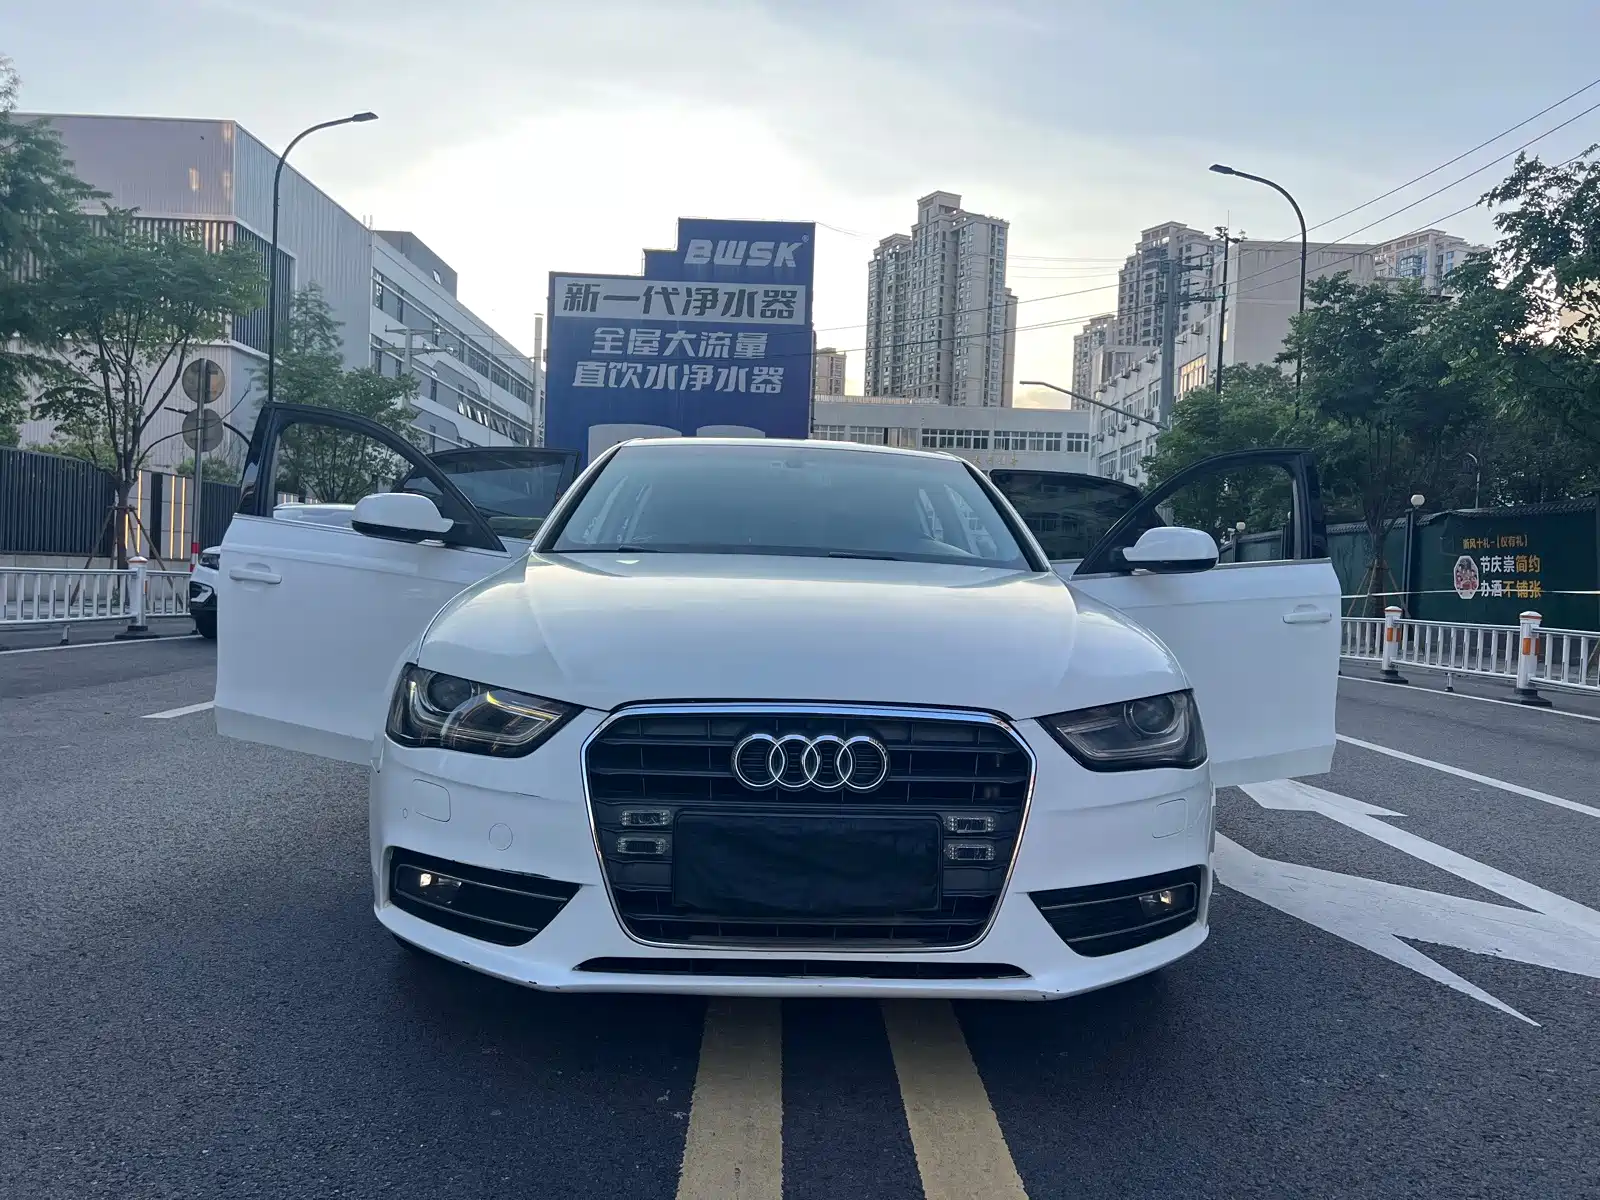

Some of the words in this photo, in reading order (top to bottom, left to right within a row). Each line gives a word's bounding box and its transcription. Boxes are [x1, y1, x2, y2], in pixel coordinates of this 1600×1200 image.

[684, 239, 802, 267] BWSK
[563, 283, 798, 319] 新一代净水器
[591, 327, 768, 359] 全屋大流量
[572, 361, 784, 394] 直饮水净水器
[1480, 555, 1540, 573] 节庆崇简约
[1480, 580, 1541, 598] 办酒不铺张
